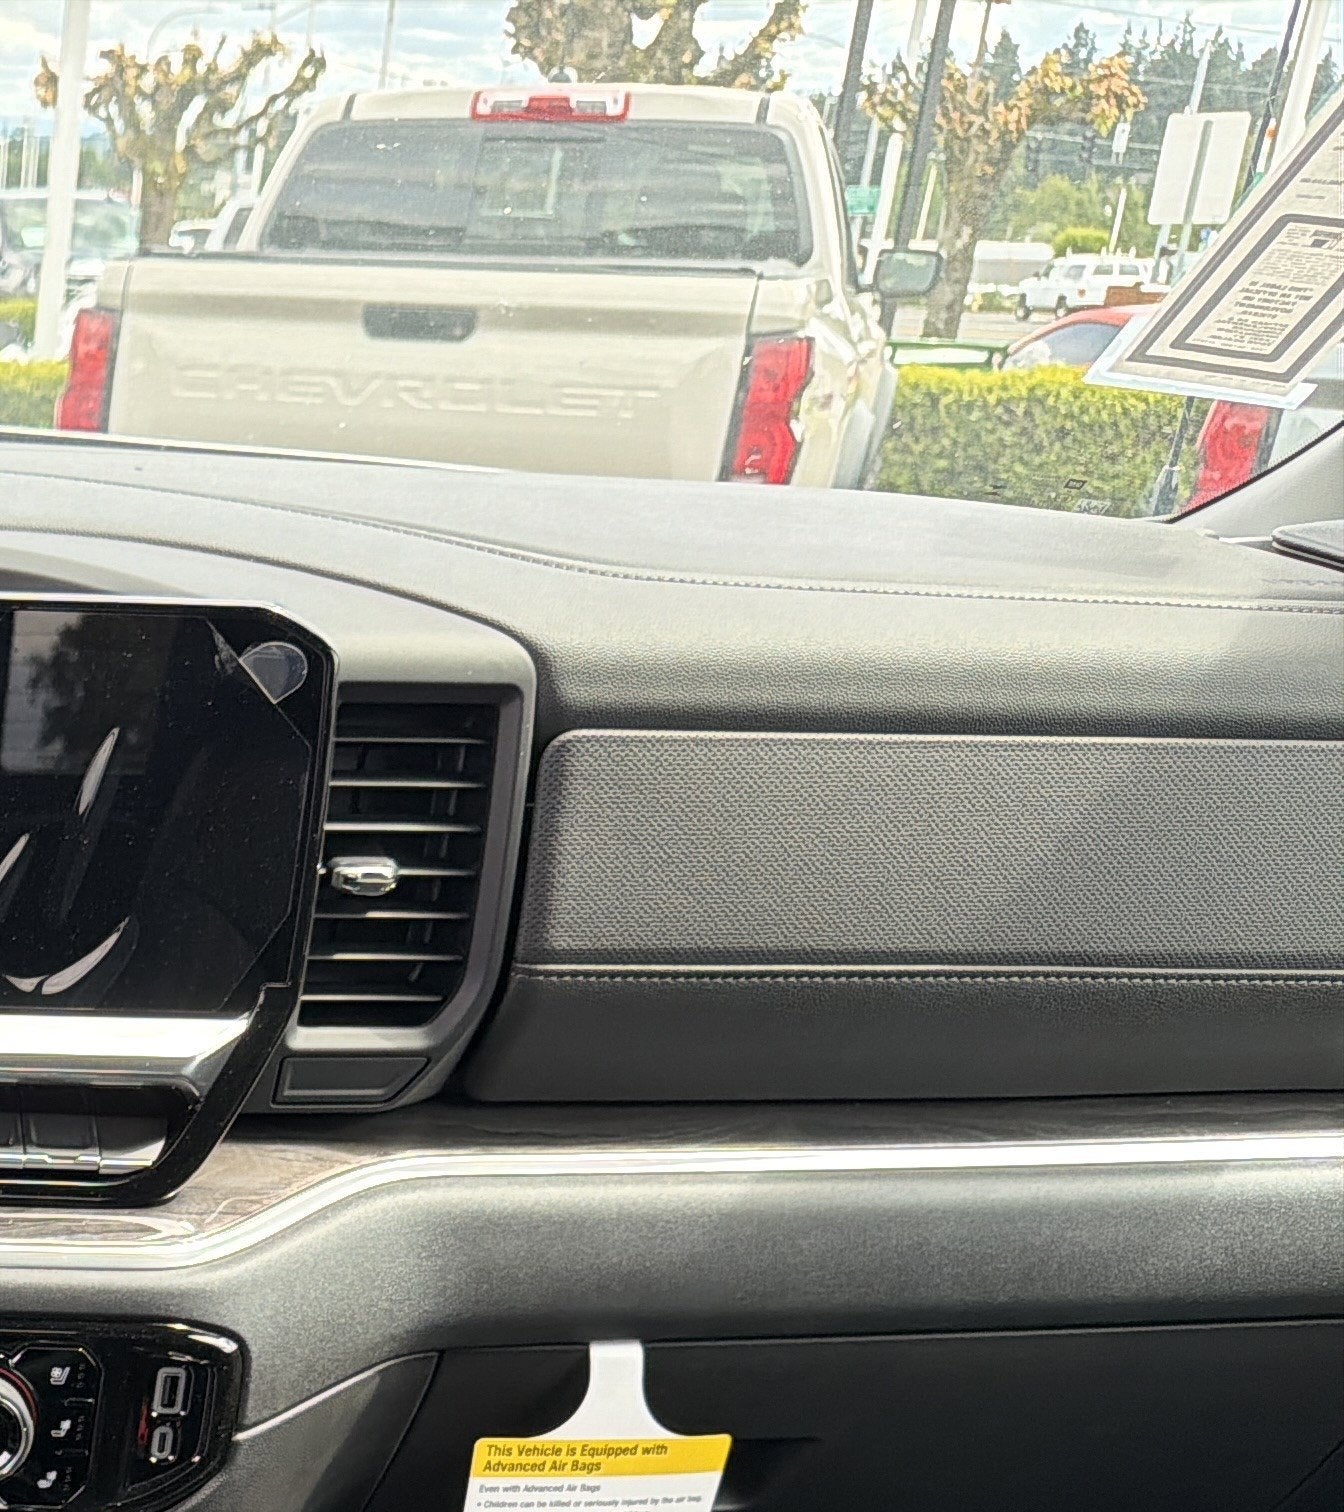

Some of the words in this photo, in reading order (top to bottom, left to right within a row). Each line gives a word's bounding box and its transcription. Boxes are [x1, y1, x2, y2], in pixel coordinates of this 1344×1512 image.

[170, 364, 661, 419] CHEVROLET
[486, 1444, 513, 1457] This
[517, 1444, 563, 1457] Vehicle
[566, 1444, 577, 1457] is
[580, 1443, 639, 1459] Equipped
[641, 1443, 668, 1456] with
[483, 1460, 547, 1473] Advanced
[548, 1460, 569, 1472] Air
[570, 1460, 602, 1475] Bags
[479, 1484, 500, 1493] Even
[502, 1484, 521, 1493] with
[523, 1484, 564, 1493] Advanced
[565, 1484, 578, 1492] Air
[580, 1484, 601, 1493] Bags
